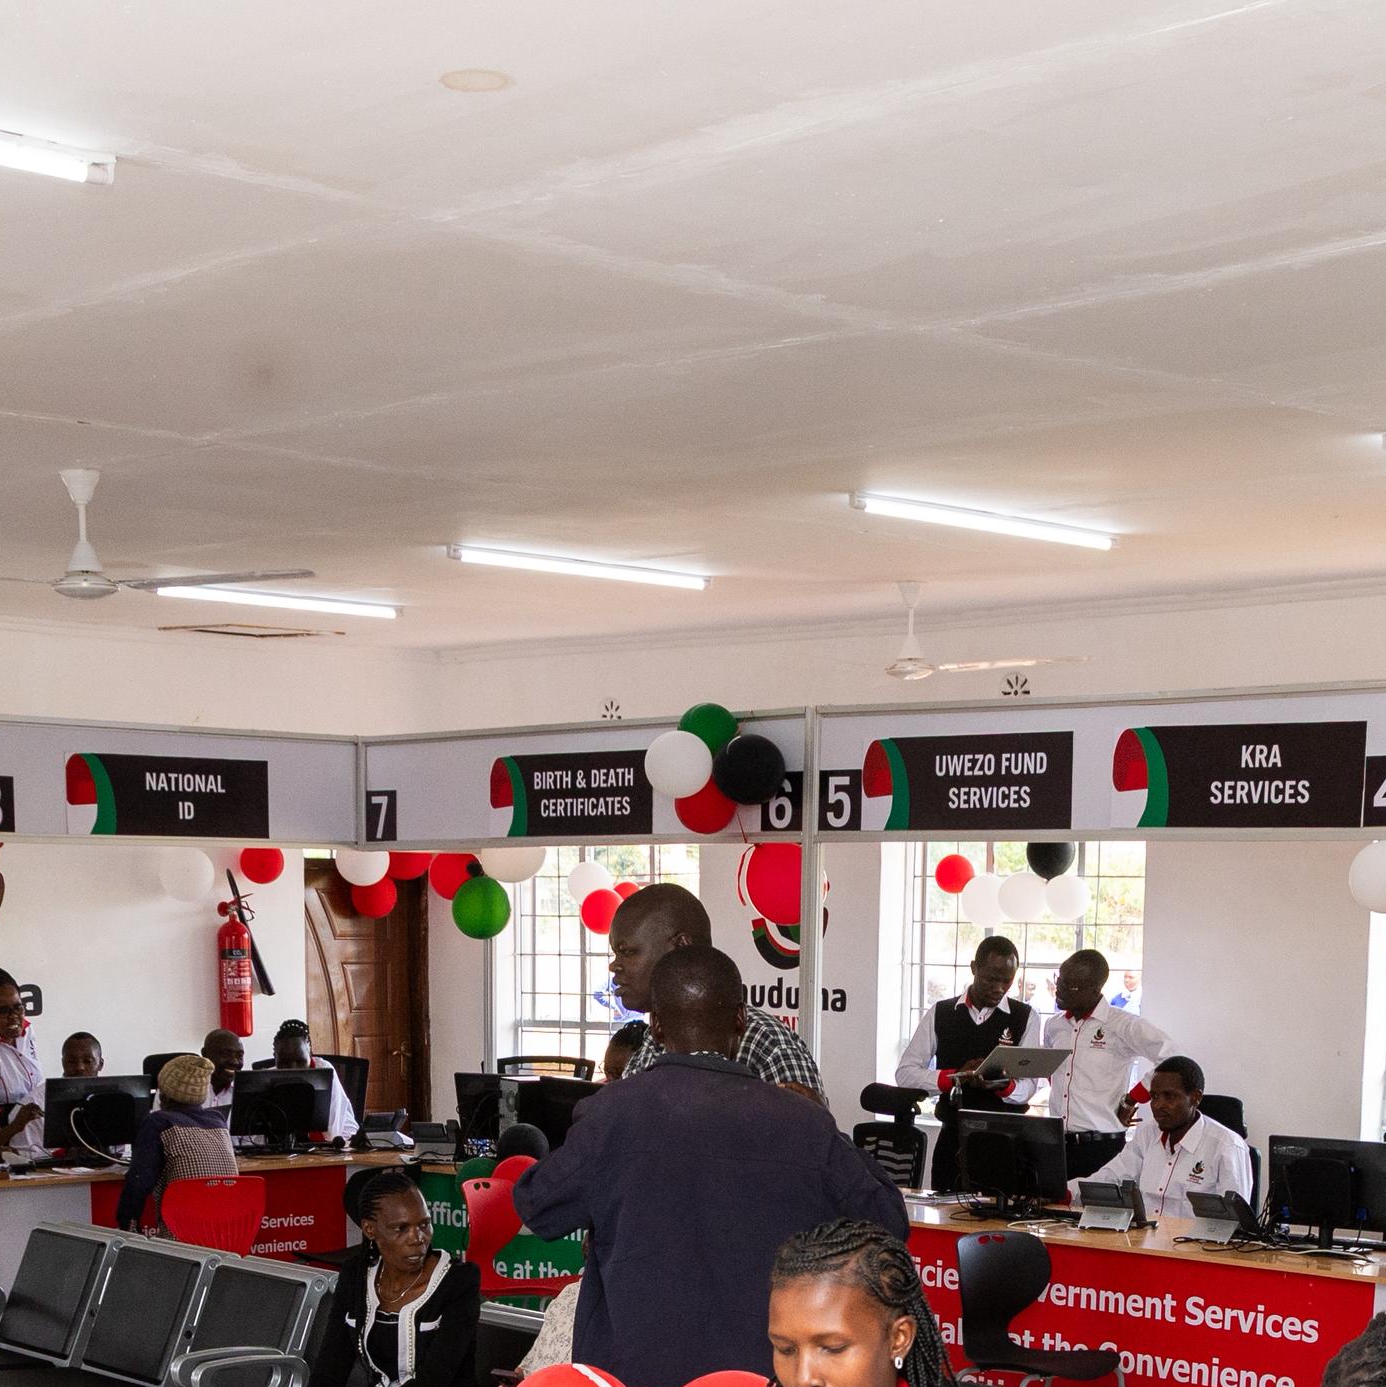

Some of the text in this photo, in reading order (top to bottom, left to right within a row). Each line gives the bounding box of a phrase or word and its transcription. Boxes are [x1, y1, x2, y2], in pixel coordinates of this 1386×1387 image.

[935, 752, 1048, 776] UWEZO FUND
[1240, 744, 1282, 768] KRA
[145, 772, 226, 793] NATIONAL
[533, 767, 634, 790] BIRTH & DEATH
[767, 779, 794, 829] 6
[826, 776, 851, 828] 5
[948, 786, 1031, 809] SERVICES
[1210, 780, 1310, 805] SERVICES
[178, 801, 195, 820] ID
[371, 796, 389, 839] 7
[540, 796, 631, 817] CERTIFICATES
[261, 1214, 315, 1229] Services
[1185, 1296, 1319, 1343] Services
